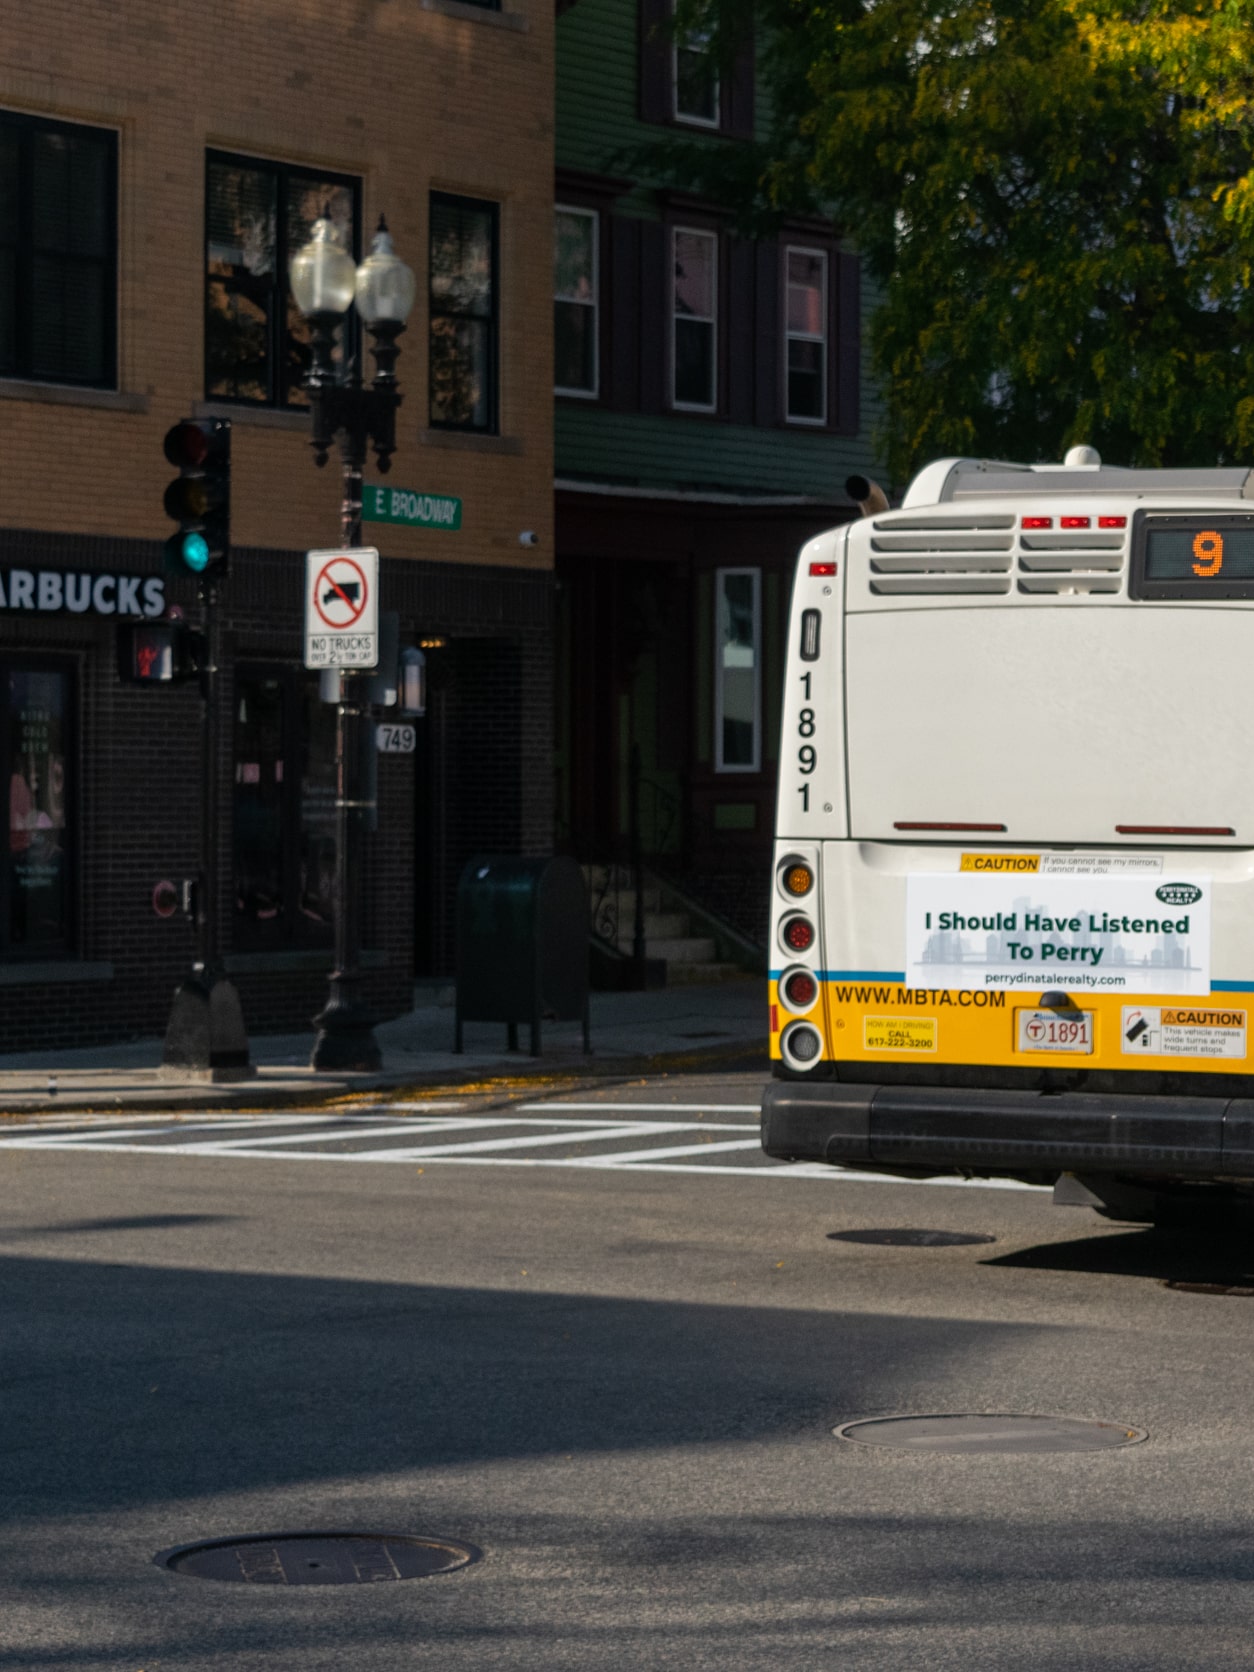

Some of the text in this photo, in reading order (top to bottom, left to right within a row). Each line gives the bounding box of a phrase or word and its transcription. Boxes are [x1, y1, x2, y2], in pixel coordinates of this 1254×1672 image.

[391, 491, 457, 524] BROADWAY
[1192, 531, 1224, 577] 9
[0, 569, 165, 617] RBUCKS
[311, 637, 371, 651] NO TRUCKS
[383, 728, 413, 750] 749
[797, 671, 818, 813] 1891
[974, 858, 1038, 870] CAUTION
[1052, 857, 1066, 867] you
[1068, 857, 1096, 865] cannot
[1114, 859, 1127, 867] my
[925, 911, 1190, 934] I Should Have Listened
[1007, 943, 1104, 966] To Perry
[985, 973, 1126, 986] perrydinatalerealty.com
[835, 986, 1006, 1007] WWW.MBTA.COM
[867, 1020, 884, 1029] HOW
[1177, 1011, 1242, 1026] CAUTION
[889, 1030, 911, 1038] CALL
[1048, 1022, 1089, 1044] 1891
[1164, 1027, 1240, 1038] This vehicle makes
[867, 1037, 933, 1048] 617-222-3200
[1164, 1037, 1184, 1046] wide
[1186, 1038, 1206, 1046] turns
[1163, 1044, 1197, 1055] frequent
